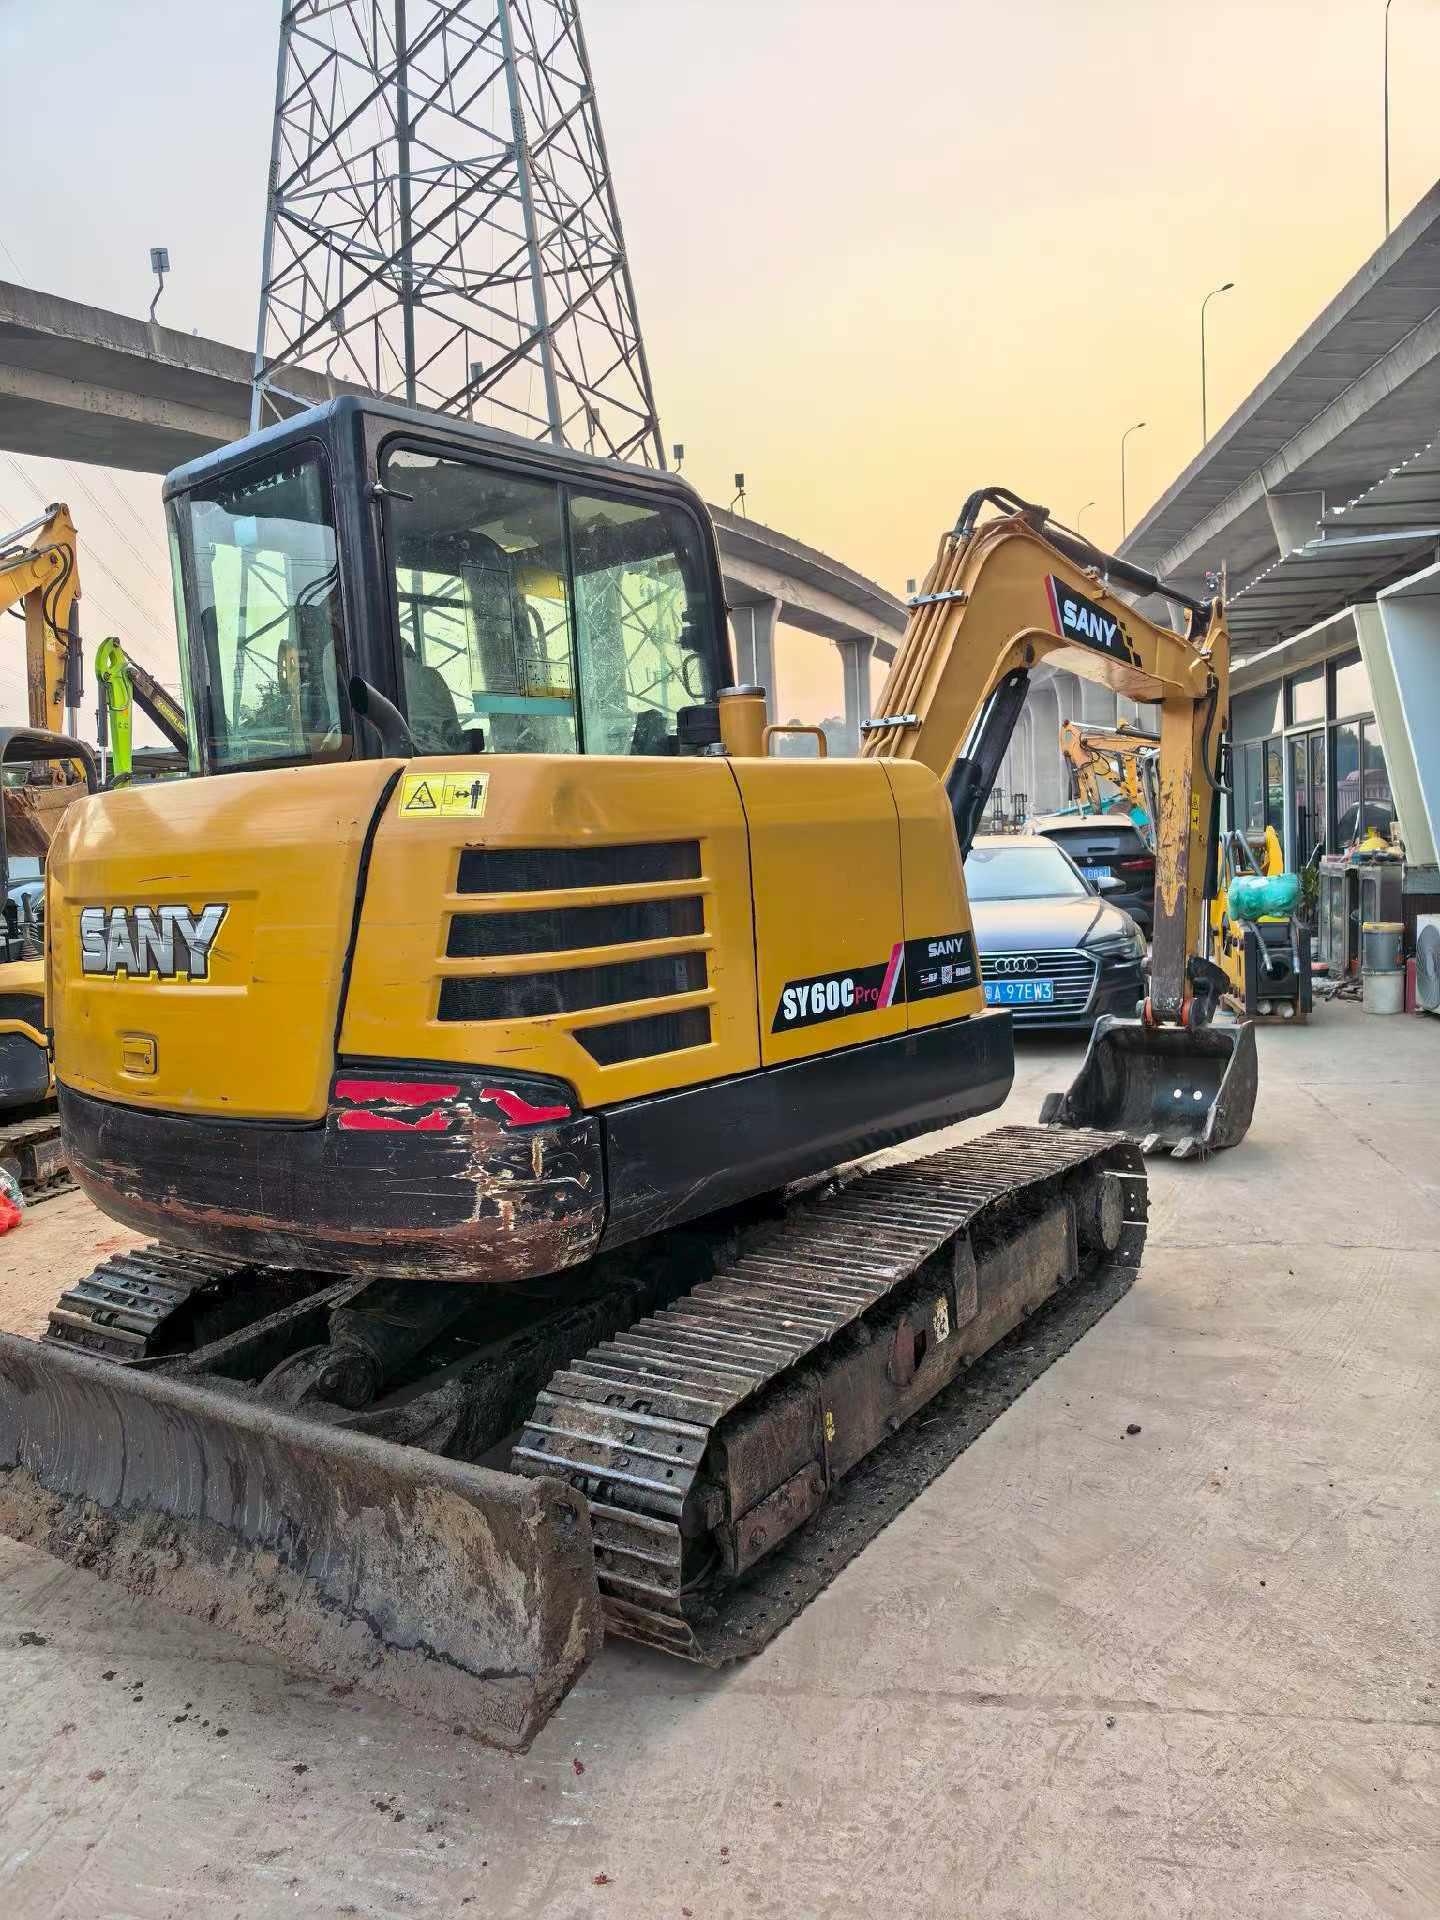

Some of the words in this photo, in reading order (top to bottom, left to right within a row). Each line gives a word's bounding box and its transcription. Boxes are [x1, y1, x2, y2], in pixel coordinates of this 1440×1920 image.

[1063, 599, 1117, 647] SANY
[79, 904, 229, 977] SANY
[928, 938, 964, 958] SANY
[783, 978, 854, 1020] SY60C
[854, 985, 880, 1005] Pro
